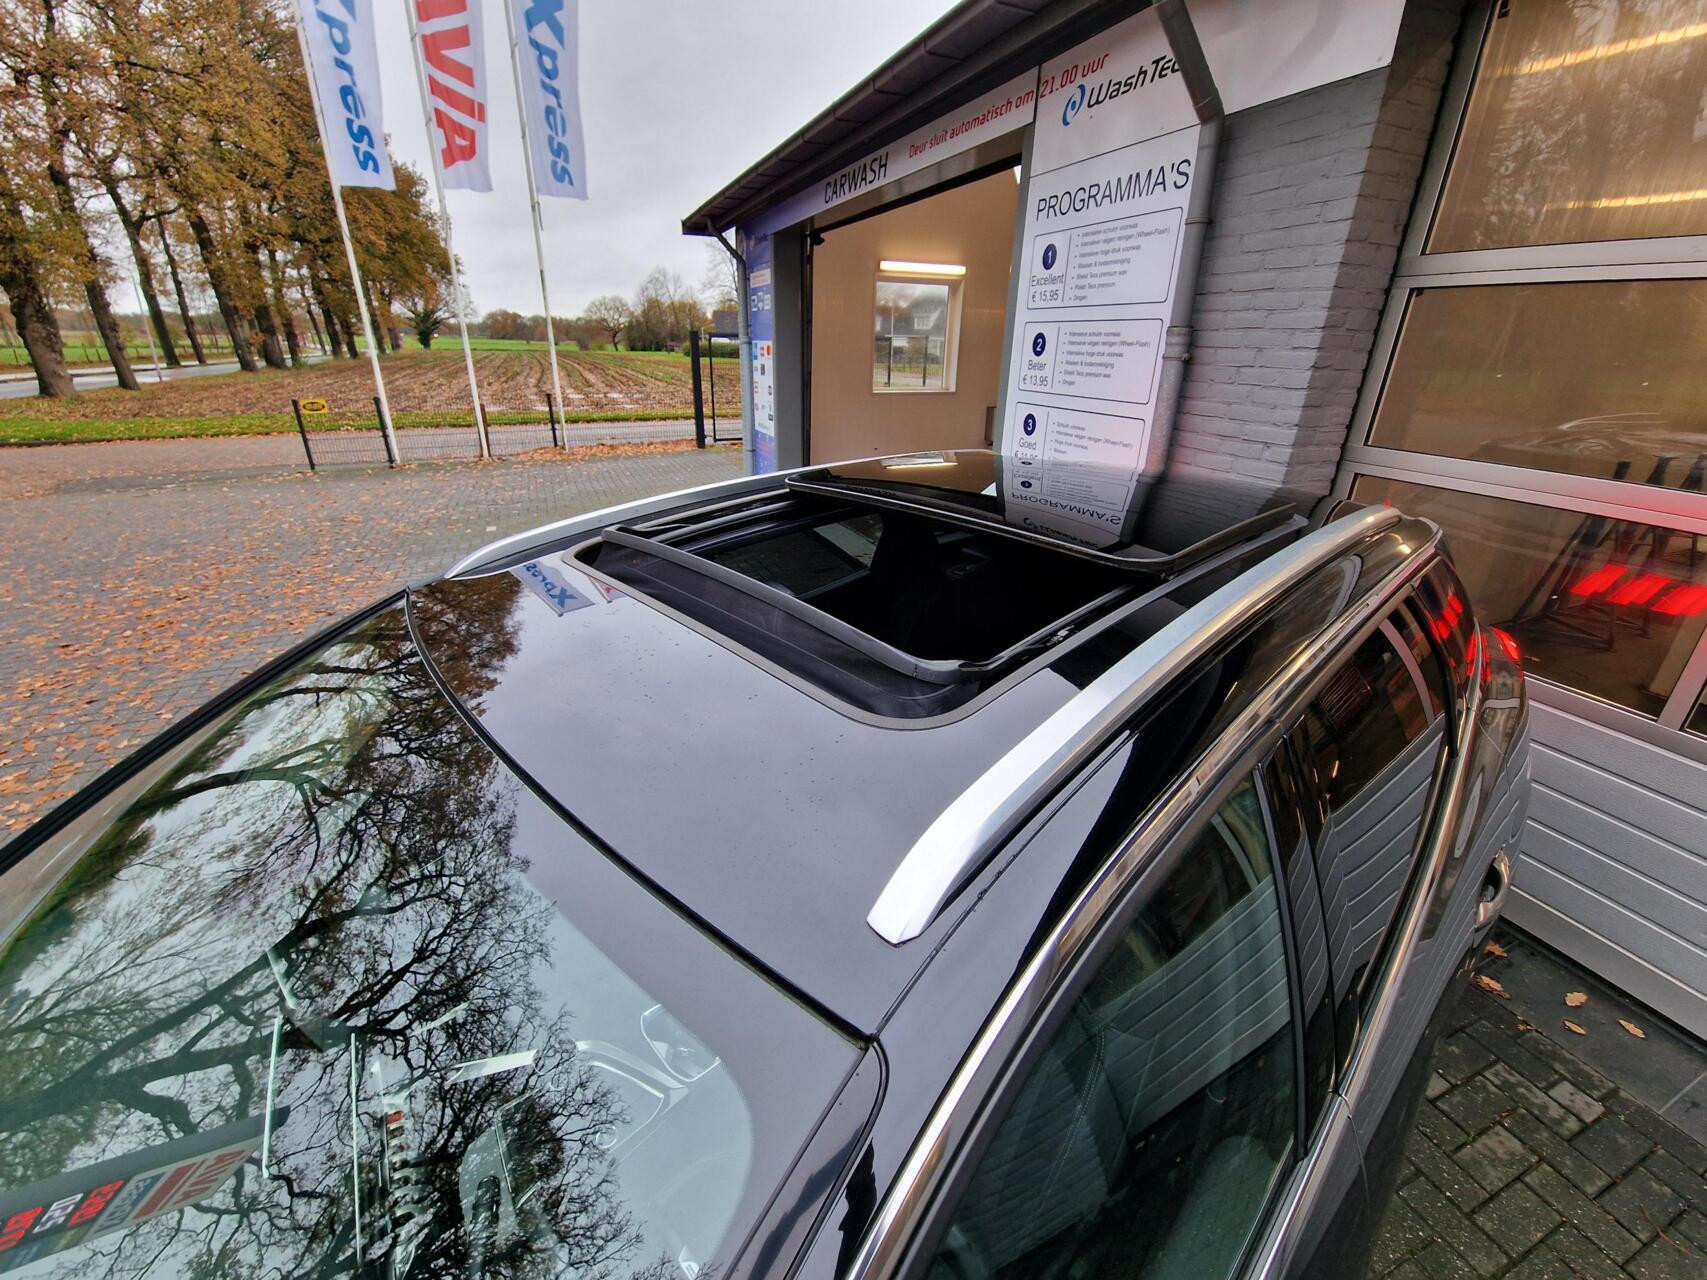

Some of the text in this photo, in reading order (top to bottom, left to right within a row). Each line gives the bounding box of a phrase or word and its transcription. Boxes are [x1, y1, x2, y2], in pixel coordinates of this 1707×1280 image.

[908, 52, 1109, 159] Deur sluit automatisch om 21.00 uur
[824, 152, 889, 204] CARWASH
[1036, 158, 1191, 221] PROGRAMMA'S
[1032, 274, 1064, 286] Excellent
[1032, 289, 1059, 302] € 15,95
[1028, 360, 1046, 371] Beter
[1023, 374, 1048, 387] € 13,95
[1019, 438, 1036, 450] Goed
